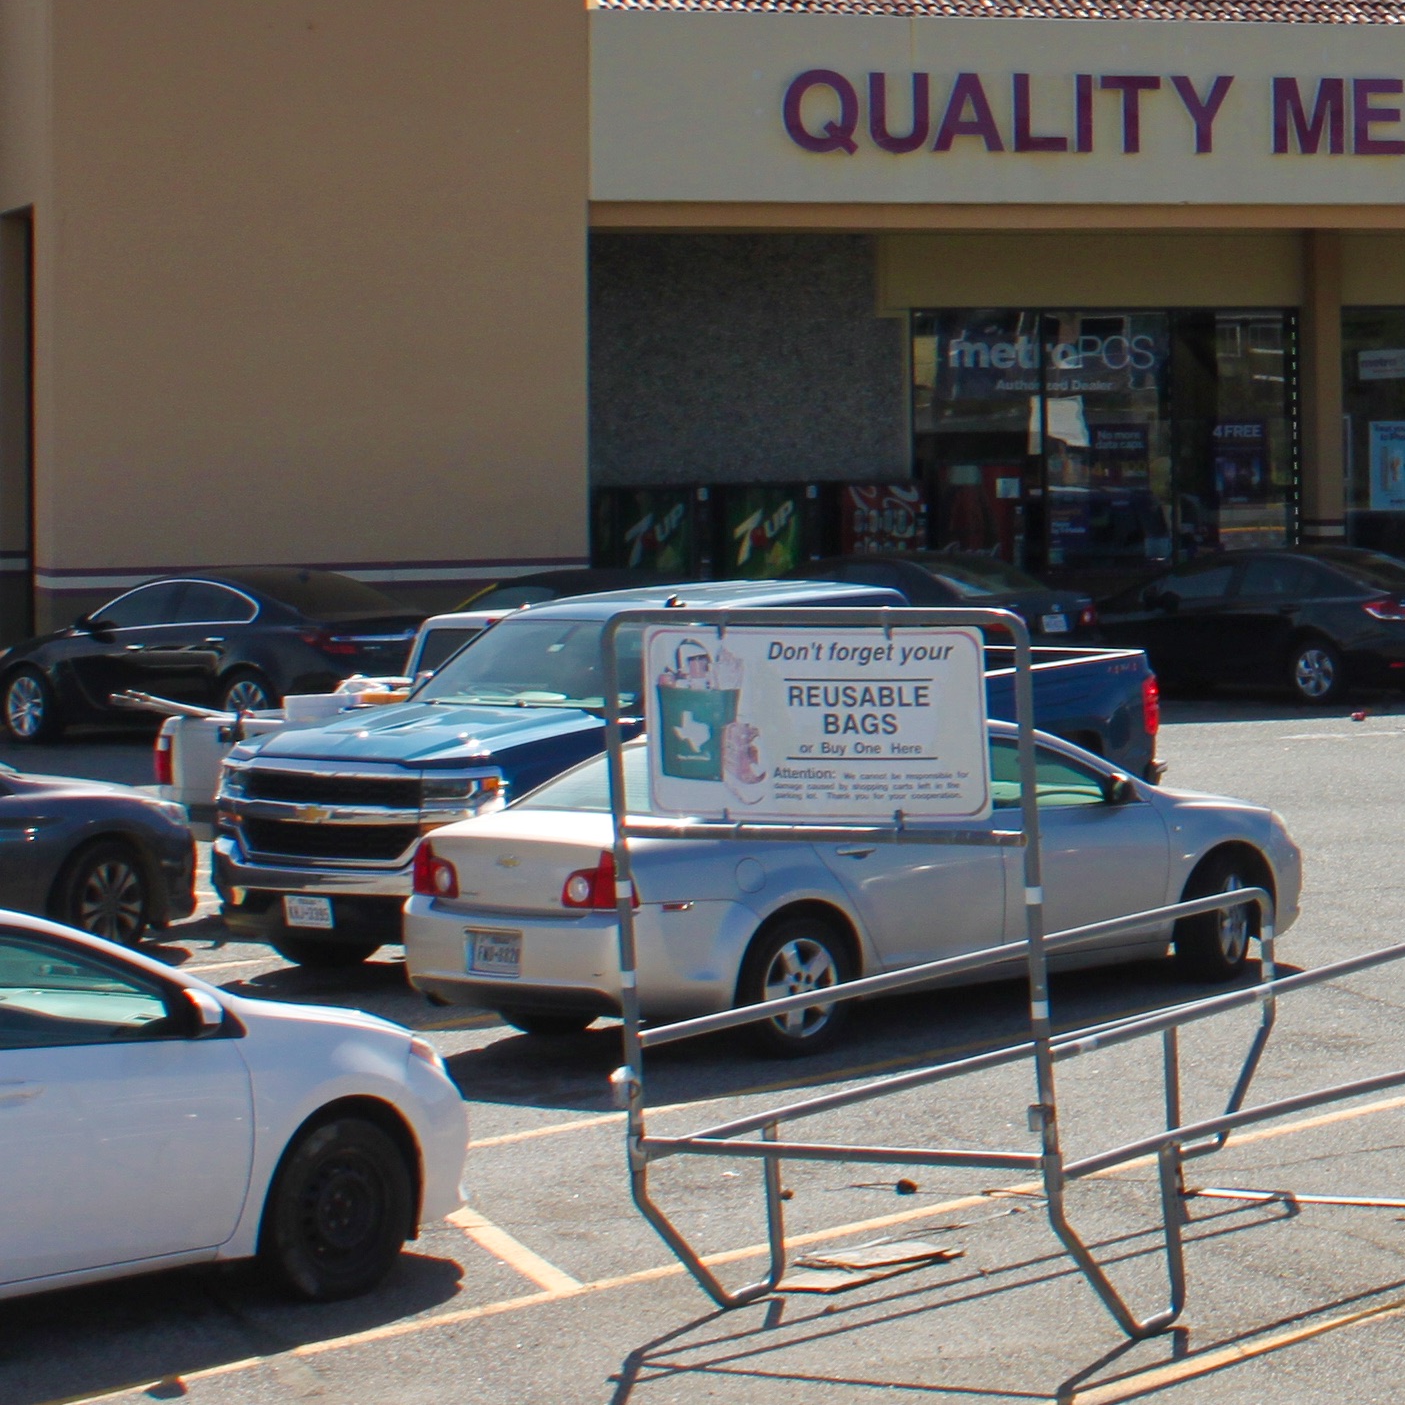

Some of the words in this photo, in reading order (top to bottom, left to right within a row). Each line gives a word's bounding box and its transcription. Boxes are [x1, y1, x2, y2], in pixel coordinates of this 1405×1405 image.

[782, 68, 1236, 156] QUALITY
[949, 335, 1155, 369] metoPCS
[1071, 379, 1113, 391] Dealer
[1099, 430, 1114, 440] No
[1116, 431, 1141, 440] more
[1224, 424, 1263, 438] FREE
[768, 642, 823, 661] Don't
[829, 642, 893, 666] forget
[900, 646, 954, 666] your
[788, 685, 931, 707] REUSABLE
[823, 713, 898, 735] BAGS
[799, 744, 814, 754] or
[821, 742, 846, 756] Buy
[854, 742, 882, 754] One
[891, 742, 923, 754] Here
[774, 767, 837, 780] Attention:
